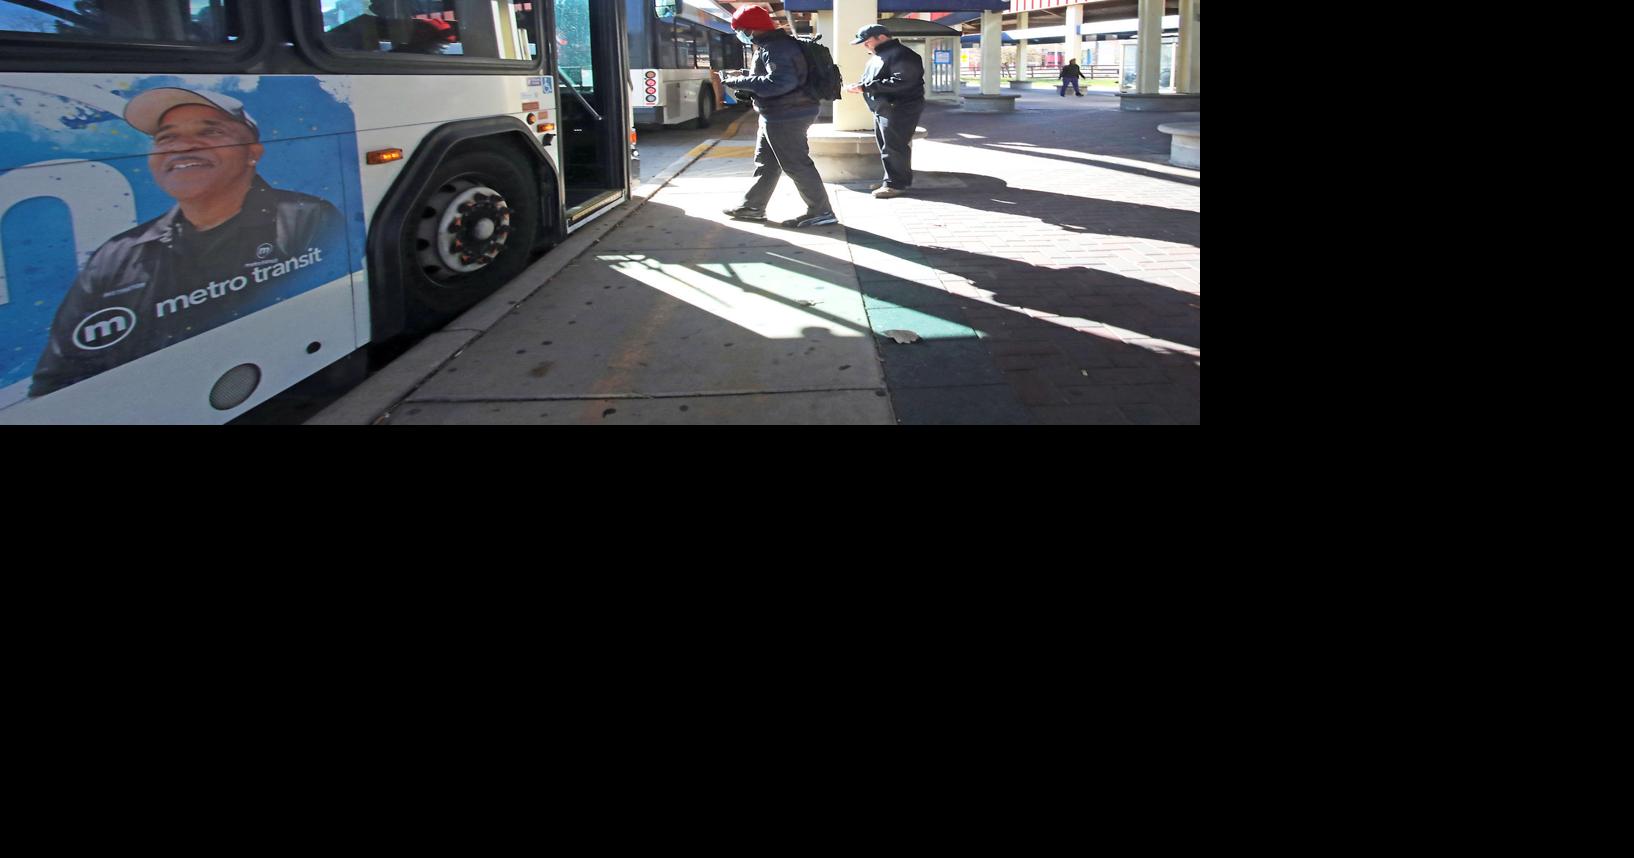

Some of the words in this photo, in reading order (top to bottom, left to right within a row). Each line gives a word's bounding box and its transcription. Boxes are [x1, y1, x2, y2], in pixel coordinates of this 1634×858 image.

[156, 275, 247, 317] metro
[252, 247, 323, 283] transit
[84, 314, 127, 342] m
